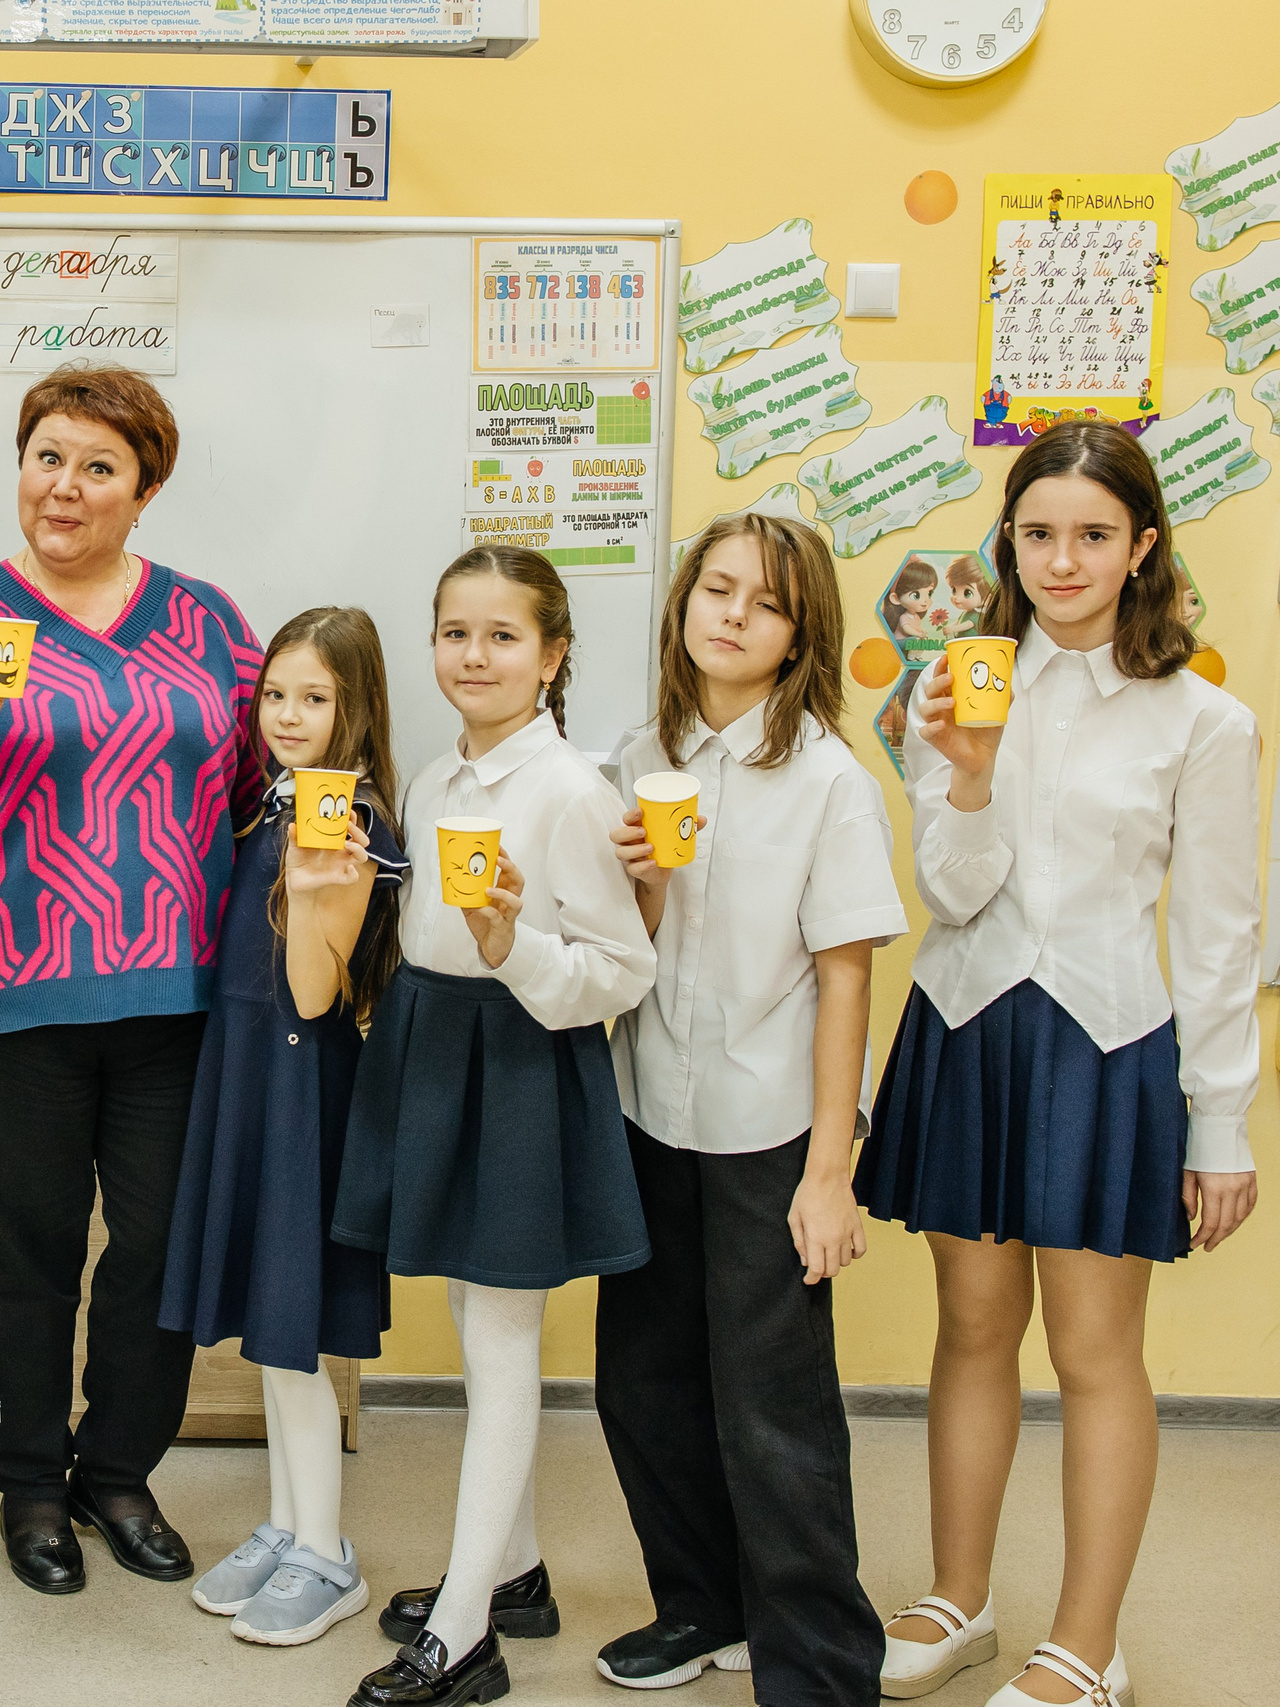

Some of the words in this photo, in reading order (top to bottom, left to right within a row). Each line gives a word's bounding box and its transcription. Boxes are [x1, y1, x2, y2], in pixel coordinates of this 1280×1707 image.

[72, 9, 126, 17] выражение
[137, 9, 190, 17] переносном
[108, 18, 148, 26] скрытое
[271, 7, 320, 16] красочное
[323, 7, 387, 16] определение
[391, 6, 440, 14] чего-либо
[272, 17, 300, 25] (чаще
[356, 16, 439, 26] прилагательное).
[882, 9, 902, 34] 8
[1002, 8, 1023, 33] 4
[907, 35, 928, 60] 7
[941, 44, 962, 69] 6
[976, 34, 997, 59] 5
[0, 92, 40, 138] Д
[47, 94, 93, 134] Ж
[102, 95, 134, 134] З
[352, 100, 377, 138] Ь
[7, 144, 40, 183] Т
[48, 145, 90, 185] Ш
[100, 145, 133, 186] С
[149, 147, 181, 186] Х
[199, 148, 233, 192] Ц
[248, 149, 277, 188] Ч
[289, 149, 334, 194] Щ
[343, 152, 375, 189] Ъ
[1184, 159, 1247, 196] Хорошая
[1247, 141, 1280, 166] книг
[1000, 194, 1044, 209] ПИШИ
[1066, 194, 1155, 210] ПРАВИЛЬНО
[1199, 174, 1277, 218] звездочки
[517, 245, 548, 255] КЛАССЫ
[549, 246, 555, 255] И
[557, 245, 593, 256] РАЗРЯДЫ
[595, 245, 618, 255] ЧИСЕЛ
[0, 234, 157, 293] декабря
[703, 281, 752, 311] умного
[753, 258, 806, 287] соседа
[1220, 287, 1266, 316] Книга
[1265, 277, 1280, 292] тв
[685, 332, 696, 343] с
[696, 309, 747, 339] книгой
[747, 277, 825, 318] побеседуй
[10, 306, 169, 364] работа
[1226, 323, 1253, 343] без
[1253, 309, 1279, 330] нее
[711, 376, 771, 410] Будешь
[771, 352, 828, 384] книжки
[477, 382, 595, 412] ПЛОЩАДЬ
[711, 408, 767, 436] читать,
[766, 384, 822, 415] будешь
[821, 371, 849, 390] все
[476, 426, 510, 437] ПЛОСКОЙ
[548, 425, 557, 435] ЕЁ
[559, 426, 595, 436] ПРИНЯТО
[489, 418, 504, 427] ЭТО
[506, 416, 555, 427] ВНУТРЕННЯЯ
[558, 416, 581, 425] ЧАСТЬ
[769, 416, 811, 441] знать
[491, 436, 540, 446] ОБОЗНАЧАТЬ
[542, 435, 571, 445] БУКВОЙ
[1160, 413, 1229, 463] добывают
[1193, 437, 1243, 470] знания
[572, 459, 647, 478] ПЛОЩАДЬ
[829, 467, 876, 496] Книги
[874, 443, 923, 473] читать
[484, 486, 494, 504] S
[571, 491, 600, 503] ДЛИНЫ
[601, 492, 608, 502] И
[609, 491, 643, 501] ШИРИНЫ
[578, 481, 639, 492] ПРОИЗВЕДЕНИЕ
[846, 488, 890, 518] скуки
[888, 479, 907, 496] не
[906, 460, 947, 487] знать
[1180, 478, 1224, 507] книги
[470, 512, 554, 533] КВАДРАТНЫЙ
[563, 514, 576, 524] ЭТО
[577, 513, 611, 523] ПЛОЩАДЬ
[613, 512, 648, 521] КВАДРАТА
[573, 523, 582, 531] СО
[584, 521, 620, 531] СТОРОНОЙ
[627, 520, 638, 529] СМ
[474, 533, 550, 548] САНТИМЕТР
[905, 639, 947, 652] ВНИМА
